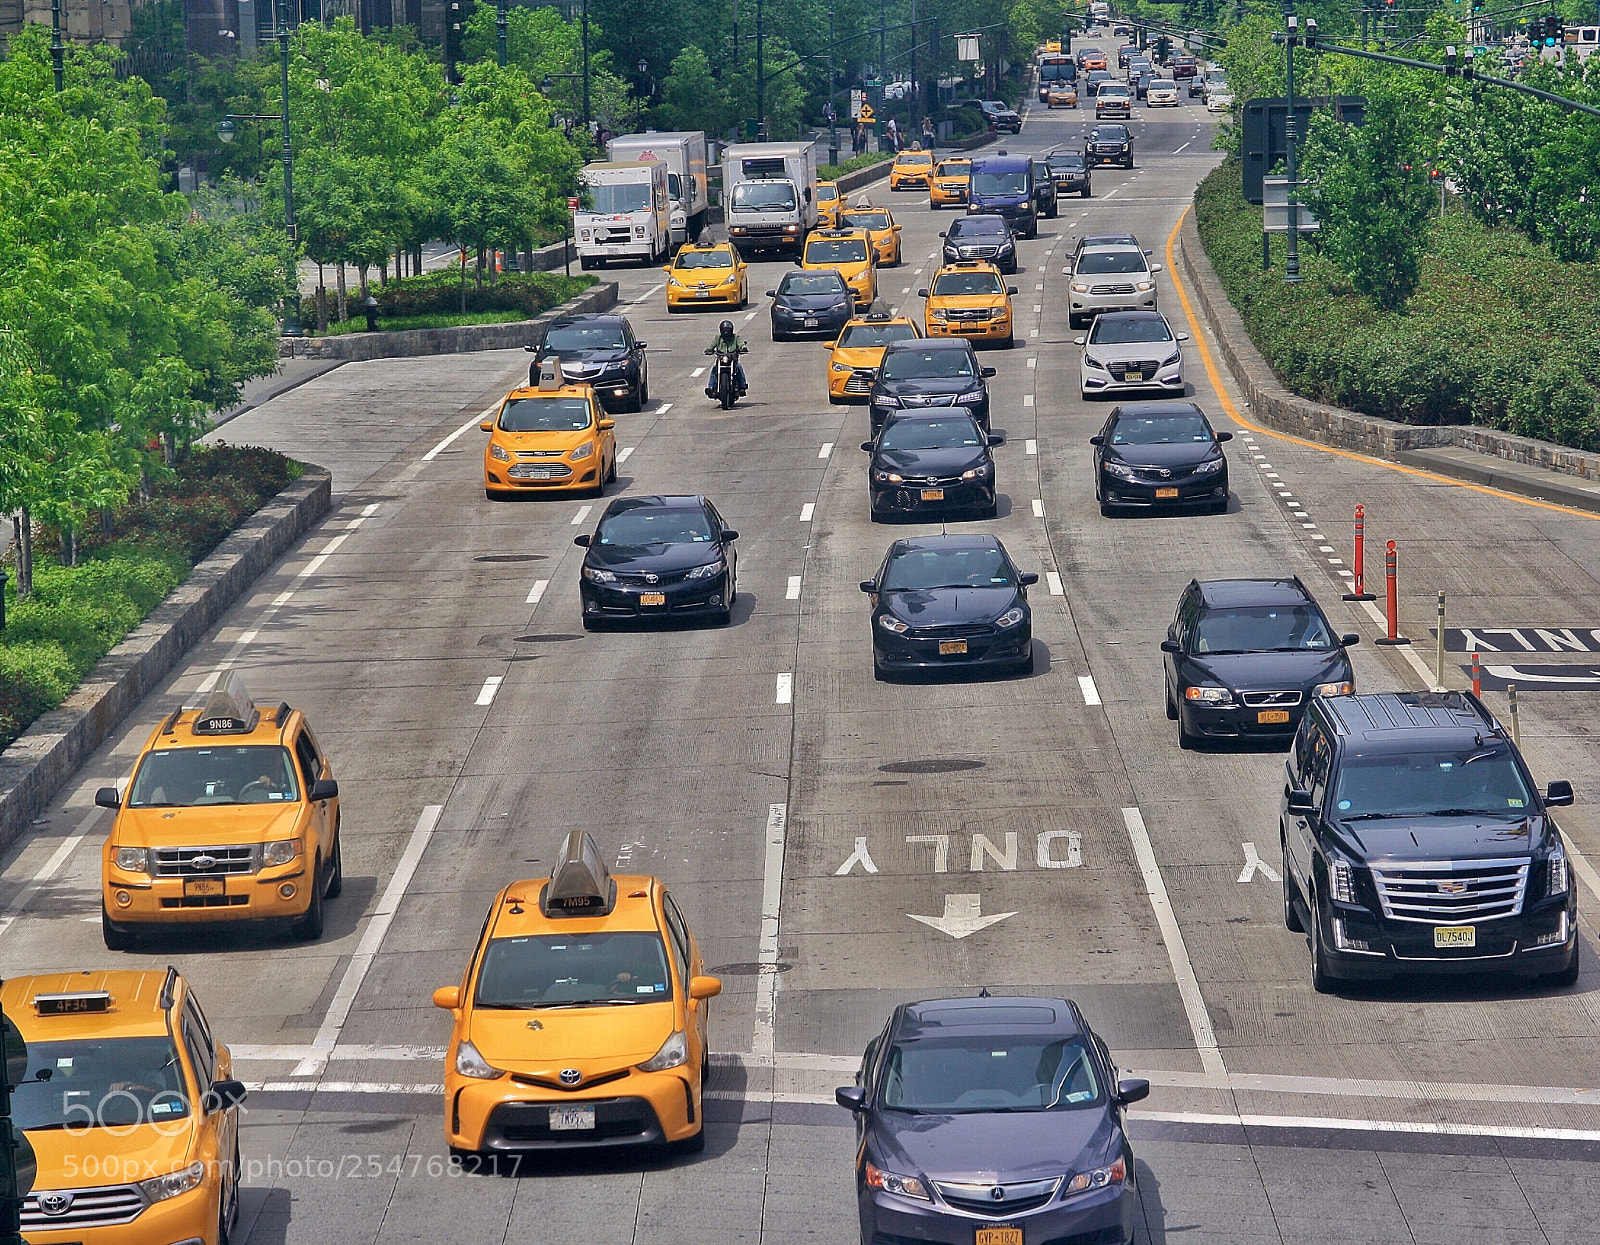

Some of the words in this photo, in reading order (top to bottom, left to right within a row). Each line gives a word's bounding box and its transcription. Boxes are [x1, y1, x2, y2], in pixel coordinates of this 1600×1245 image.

[209, 719, 233, 730] 9N86
[834, 829, 1083, 875] ONLY
[563, 896, 590, 908] 7M95
[56, 999, 88, 1012] 4F34
[978, 1231, 1019, 1244] GVP-1827
